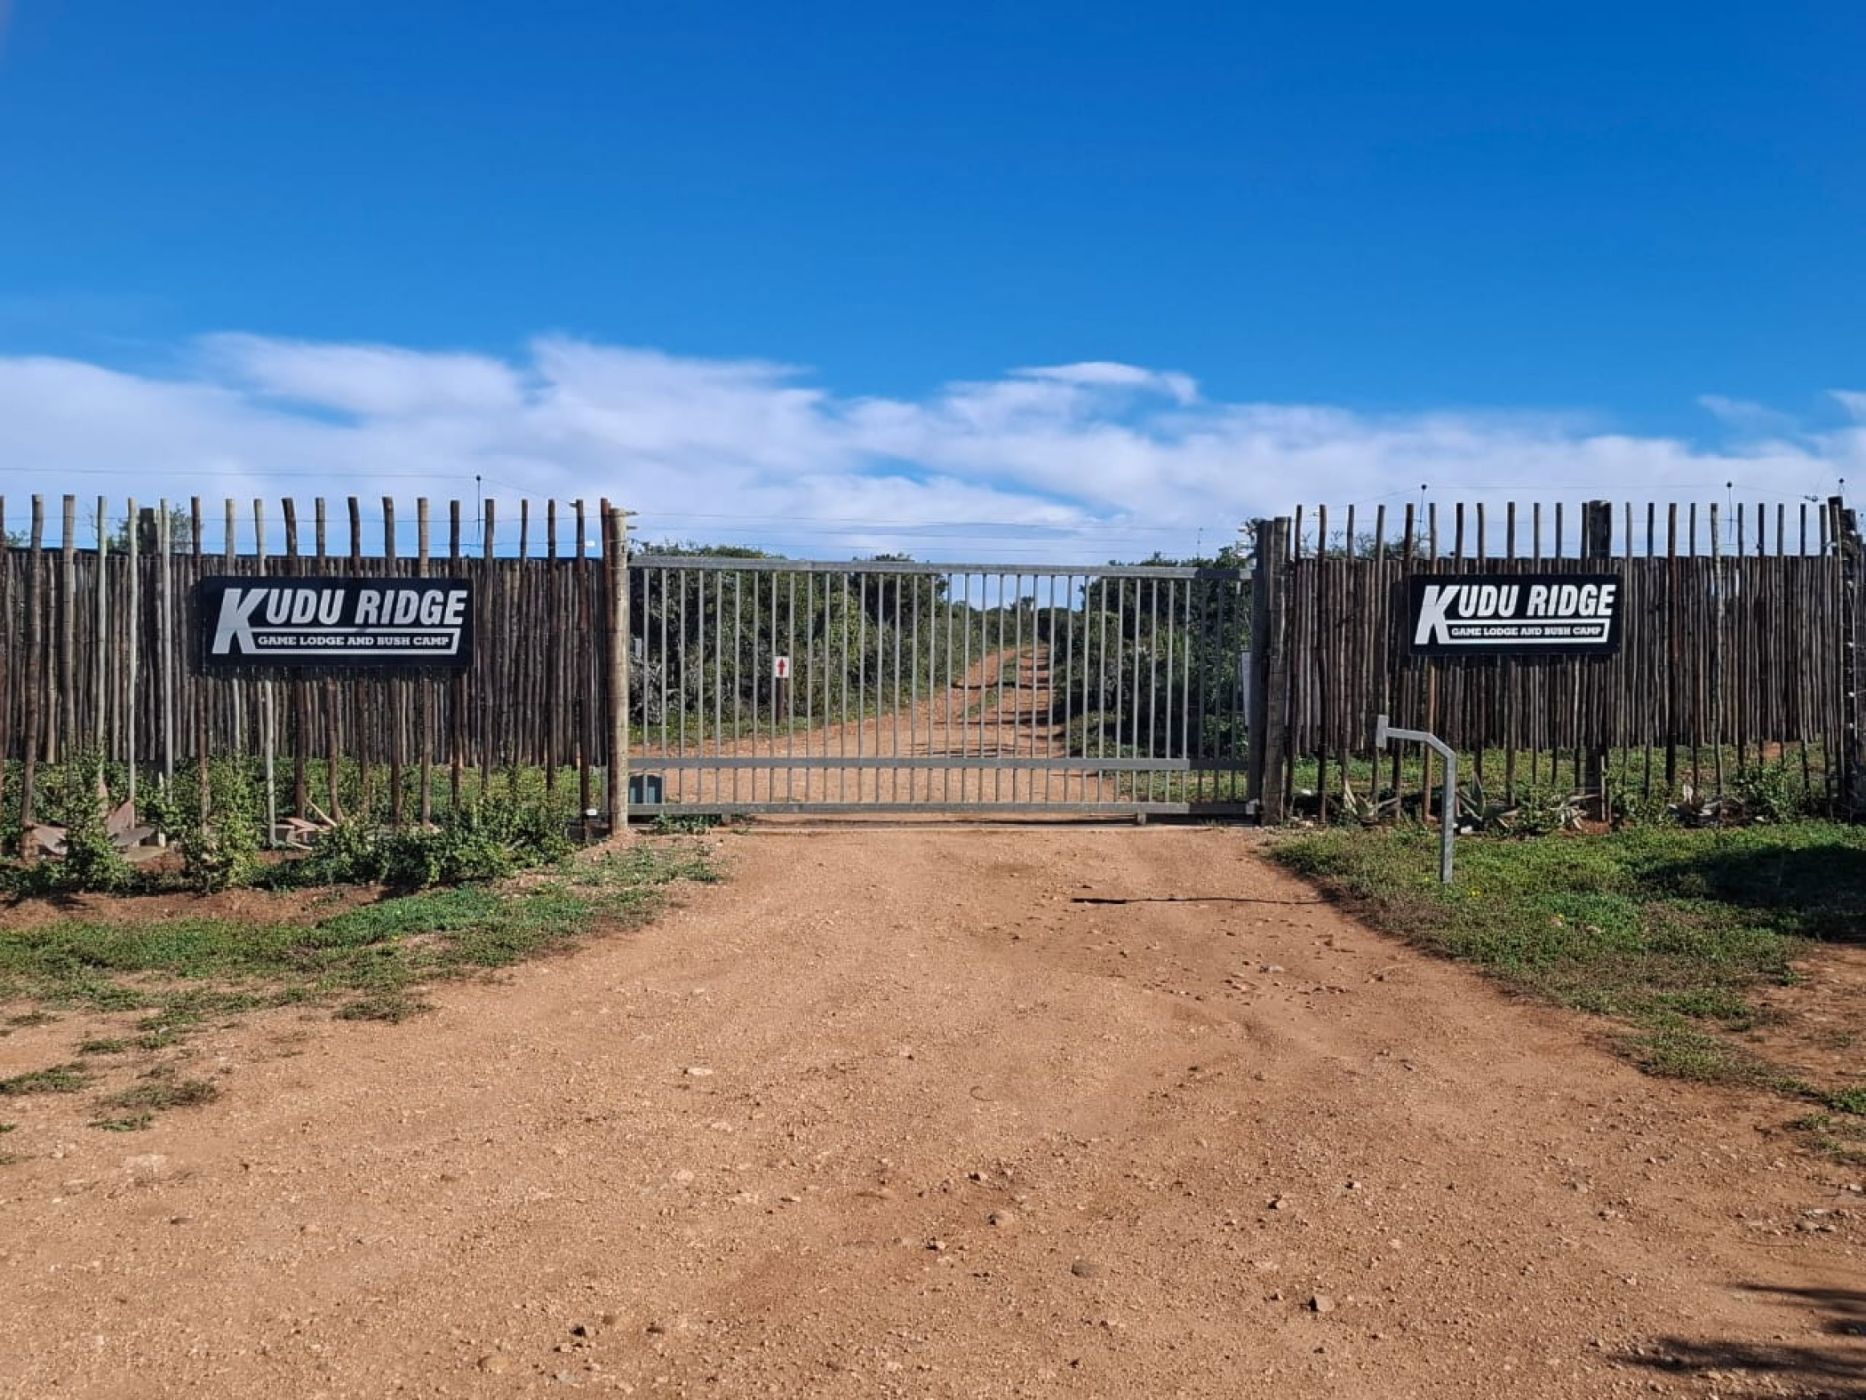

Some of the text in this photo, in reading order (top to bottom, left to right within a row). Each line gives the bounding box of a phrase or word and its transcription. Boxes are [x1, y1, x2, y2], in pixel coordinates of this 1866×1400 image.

[212, 588, 468, 654] KUDU RIDGE
[1414, 584, 1617, 645] KUDU RIDGE
[1451, 627, 1482, 637] GAME
[1484, 627, 1519, 637] LODGE
[1521, 627, 1542, 637] AND
[258, 636, 450, 646] GAME LODGE AND BUSH CAMP
